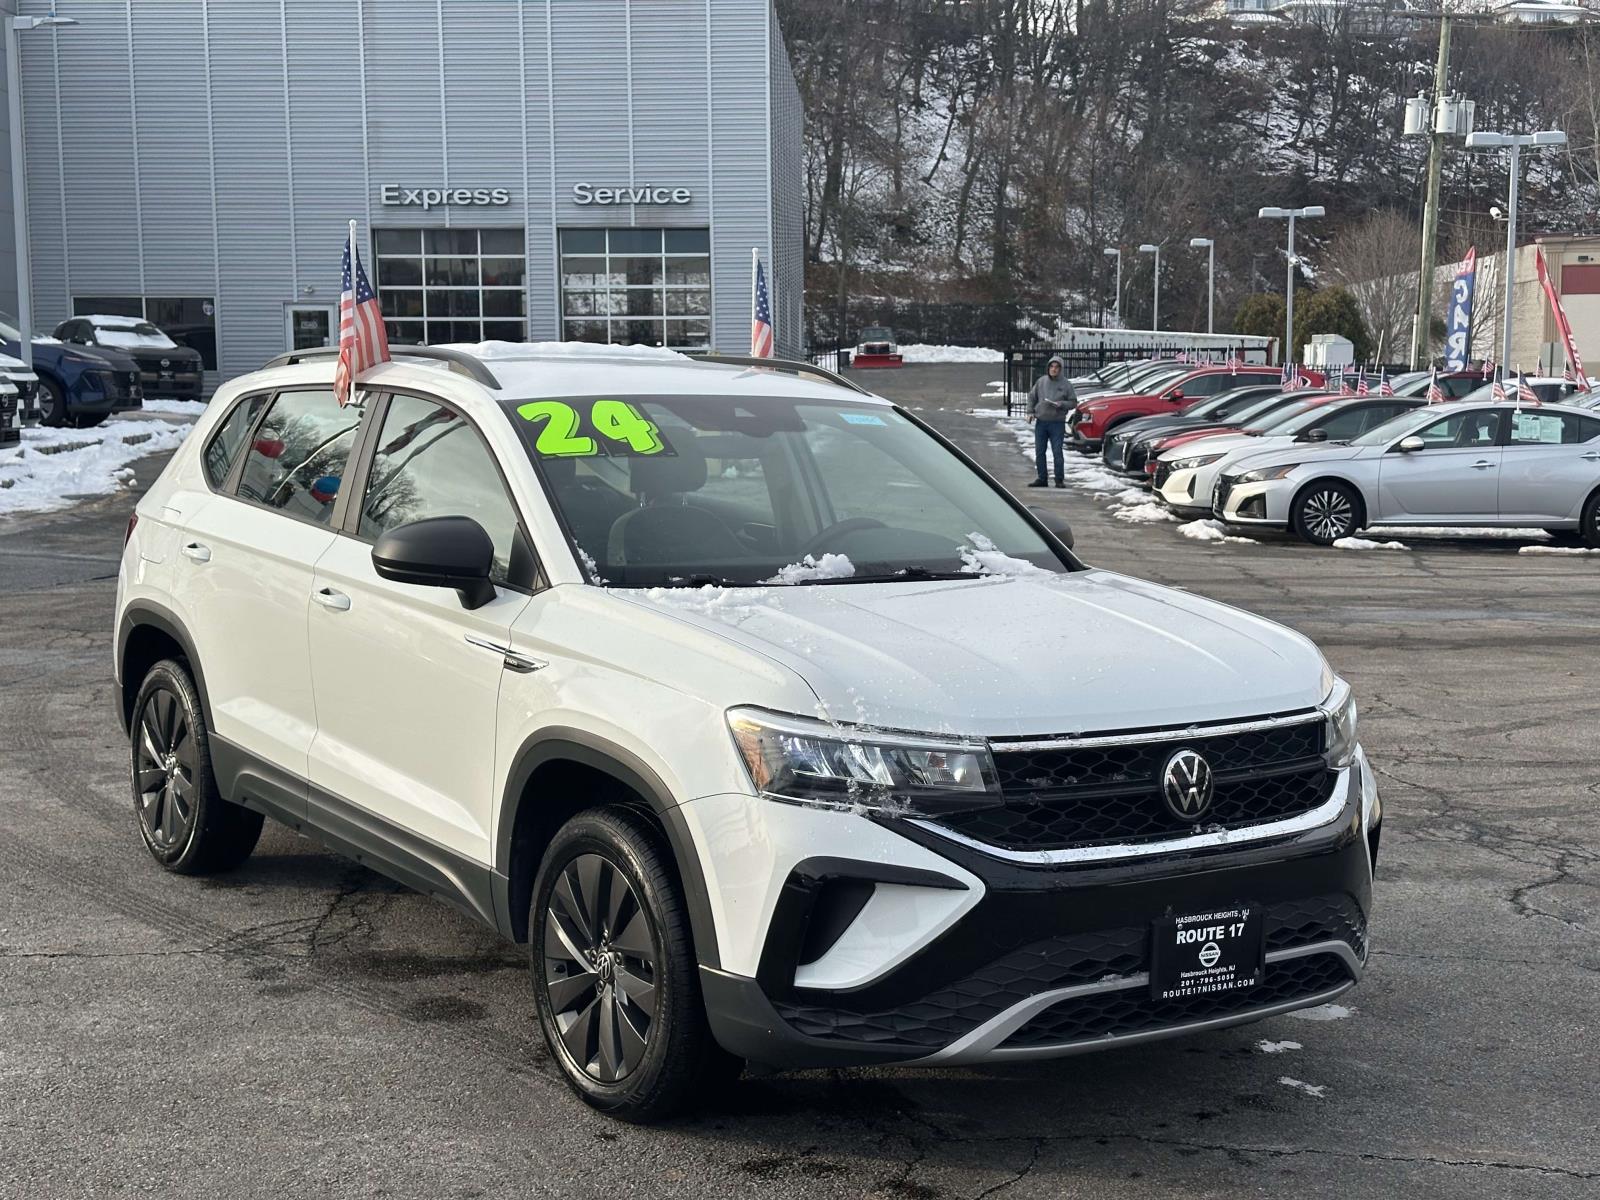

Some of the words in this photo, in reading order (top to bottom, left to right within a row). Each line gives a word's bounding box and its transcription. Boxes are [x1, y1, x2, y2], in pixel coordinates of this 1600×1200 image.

[380, 183, 509, 210] Express
[572, 182, 691, 206] Service
[517, 400, 664, 456] 24
[1175, 913, 1213, 924] HASBROUCK
[1242, 908, 1250, 916] NJ
[1176, 925, 1225, 945] ROUTE
[1229, 922, 1245, 938] 17
[1180, 969, 1208, 978] Hasbrouck
[1162, 978, 1255, 999] ROUTE17NISSAN.COM
